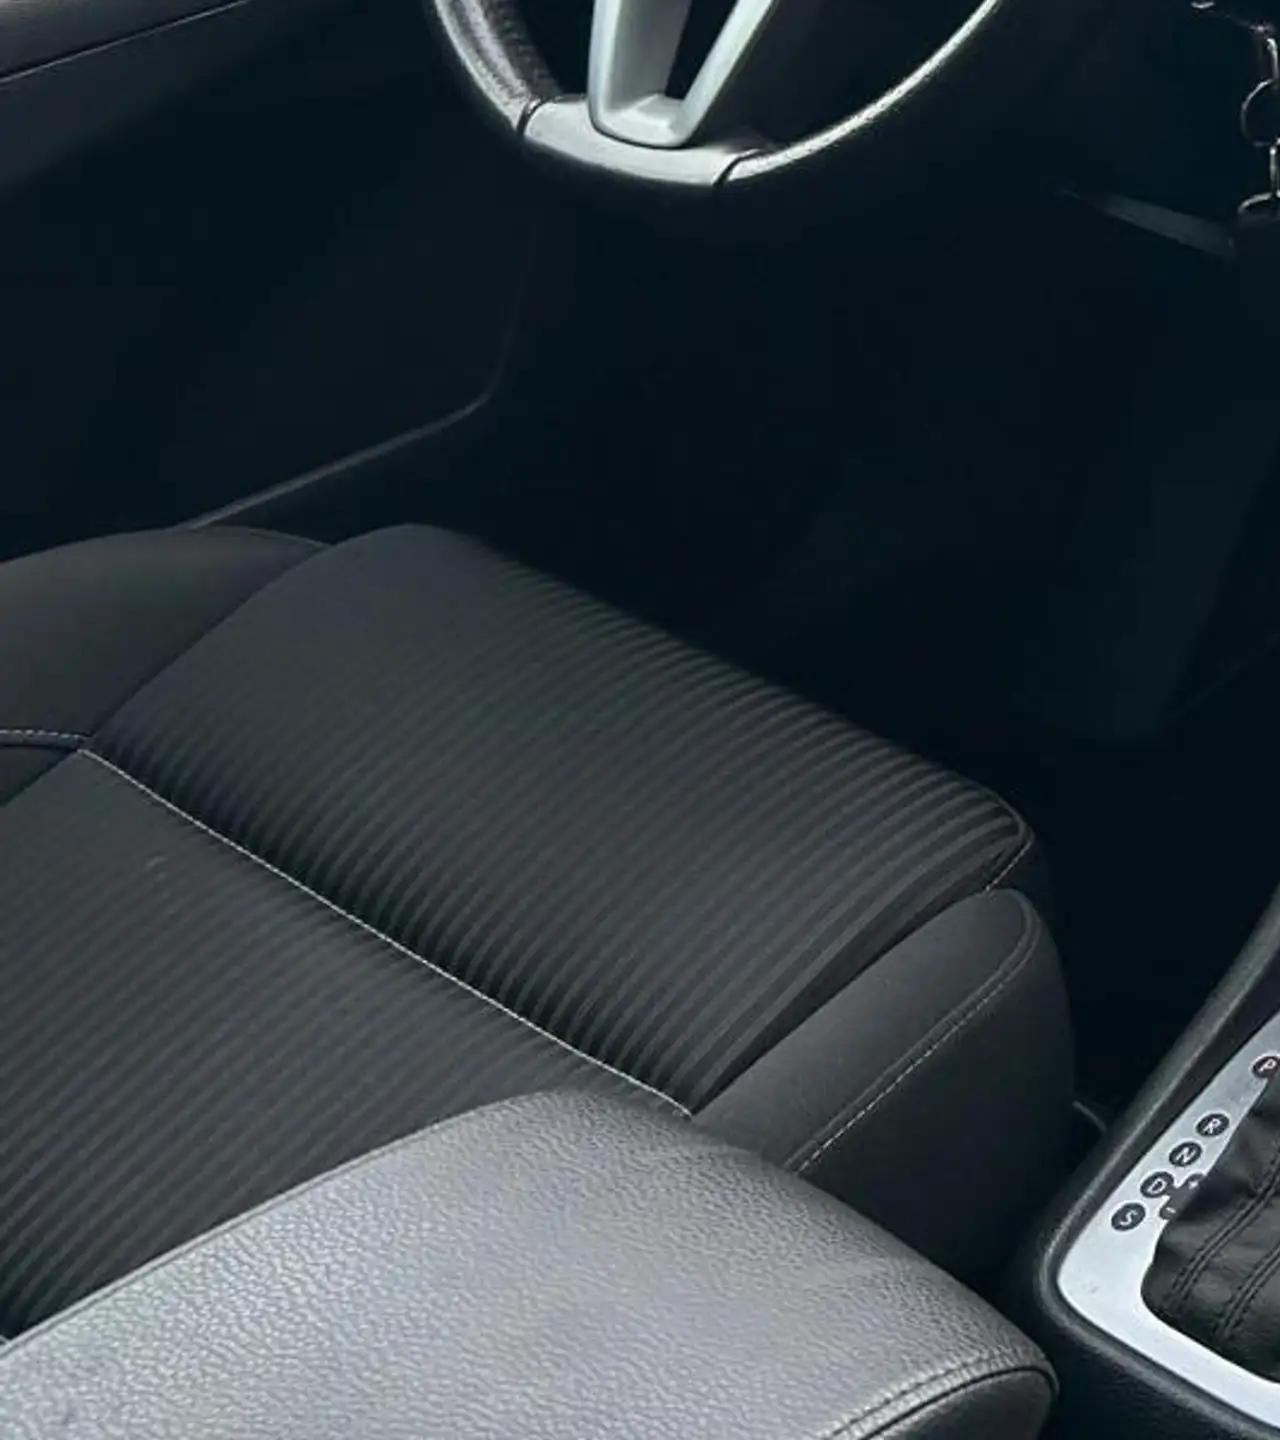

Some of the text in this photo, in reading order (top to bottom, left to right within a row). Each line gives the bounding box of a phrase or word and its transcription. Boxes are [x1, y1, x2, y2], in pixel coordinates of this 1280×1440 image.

[1204, 1118, 1221, 1135] R
[1176, 1148, 1196, 1164] N
[1120, 1210, 1138, 1226] S
